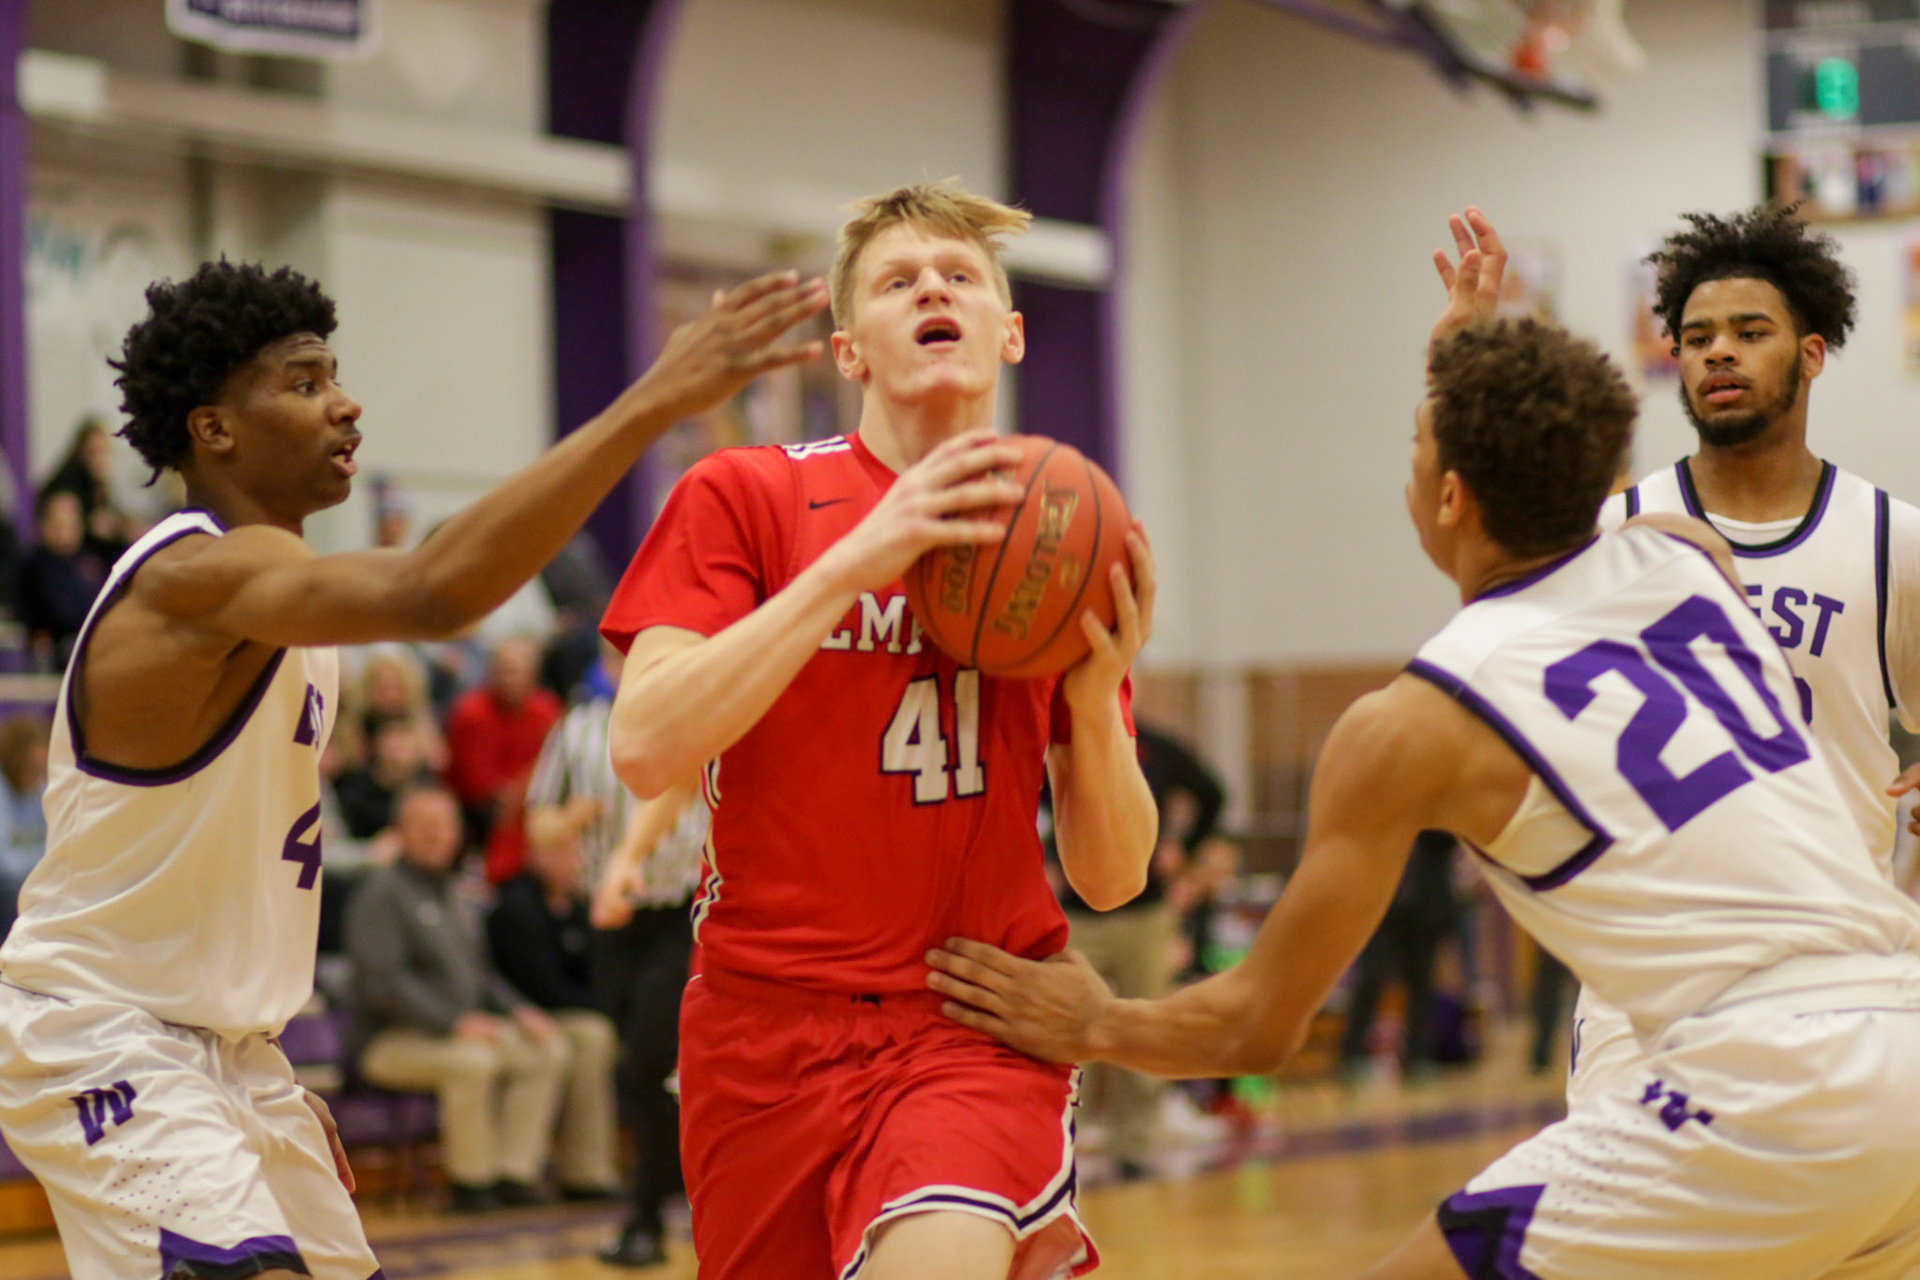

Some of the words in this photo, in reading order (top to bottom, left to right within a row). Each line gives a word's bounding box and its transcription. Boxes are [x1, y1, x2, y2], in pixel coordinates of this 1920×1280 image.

[879, 668, 985, 806] 41
[1543, 594, 1811, 834] 20
[281, 800, 322, 890] 4
